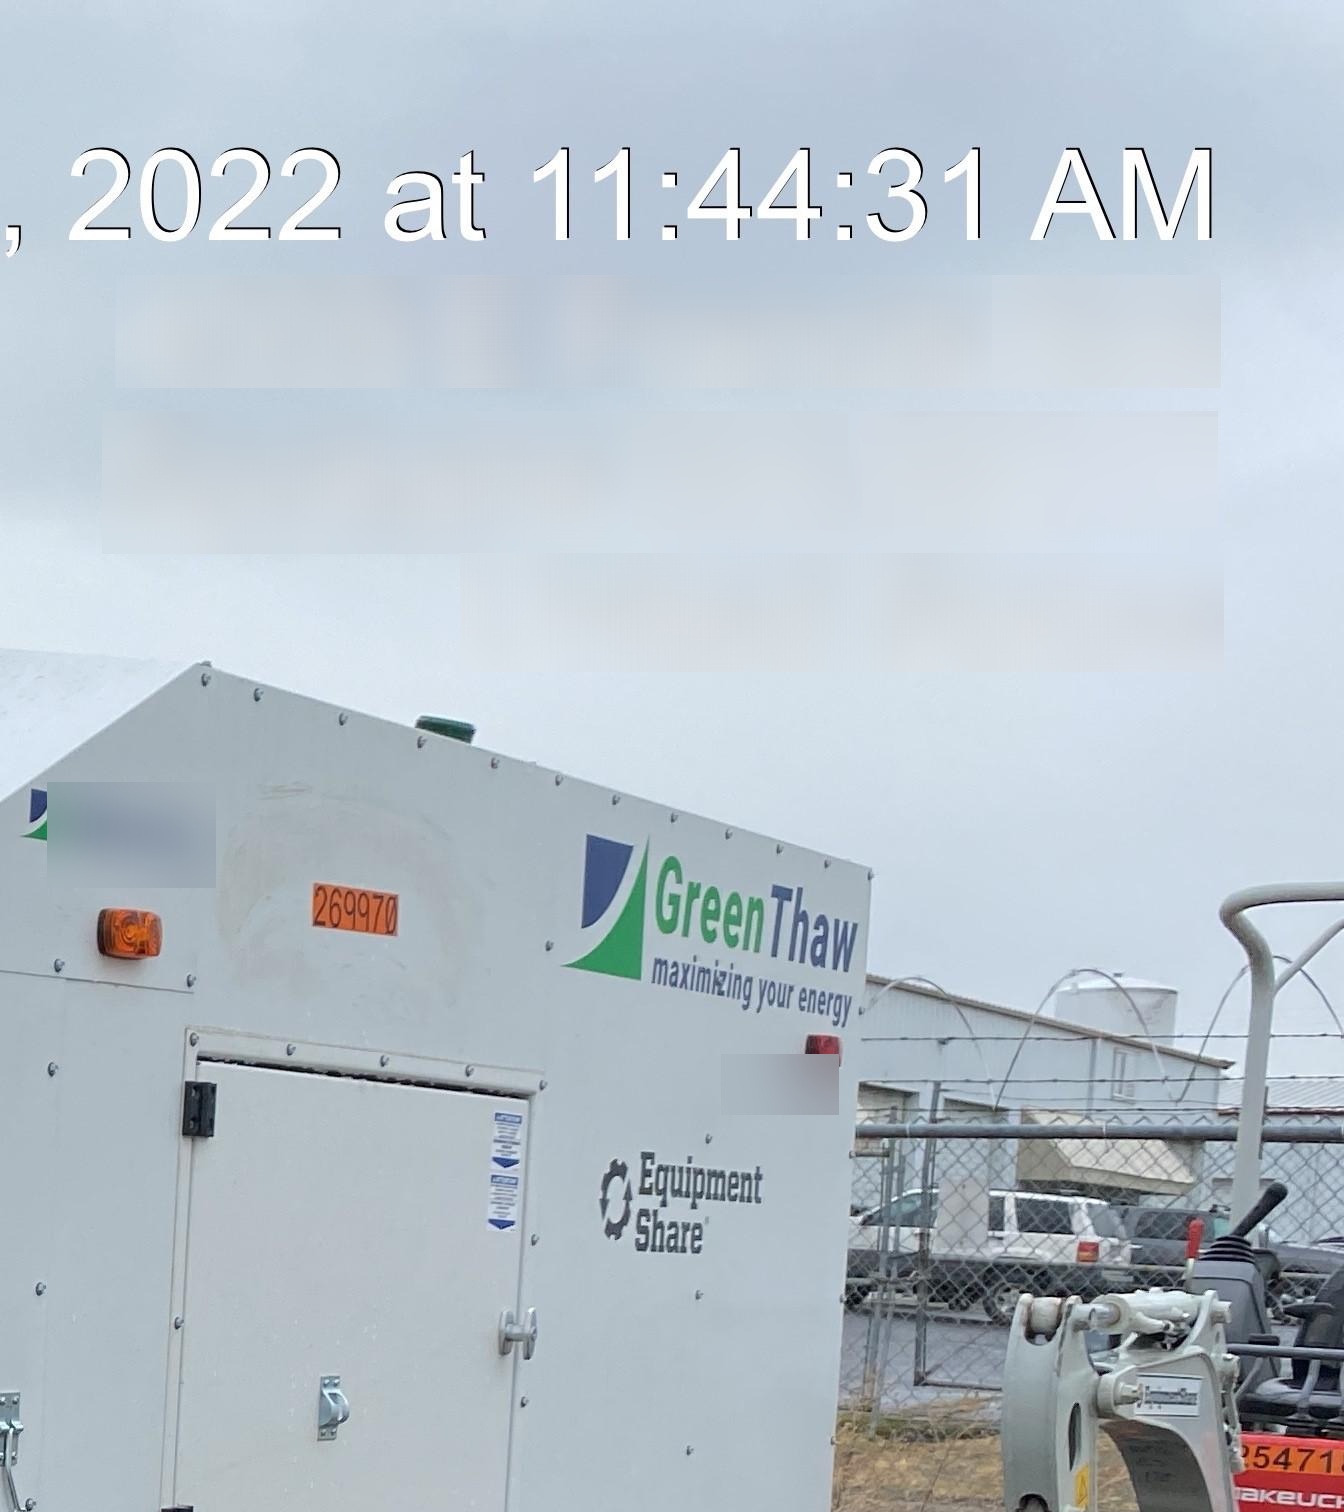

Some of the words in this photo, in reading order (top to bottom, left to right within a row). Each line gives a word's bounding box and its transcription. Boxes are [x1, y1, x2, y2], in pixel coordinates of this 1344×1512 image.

[313, 885, 398, 934] 269970
[651, 955, 754, 1011] maximizing
[756, 977, 795, 1014] your
[798, 986, 853, 1029] energy
[638, 1151, 764, 1210] Equipment
[634, 1208, 704, 1254] Share
